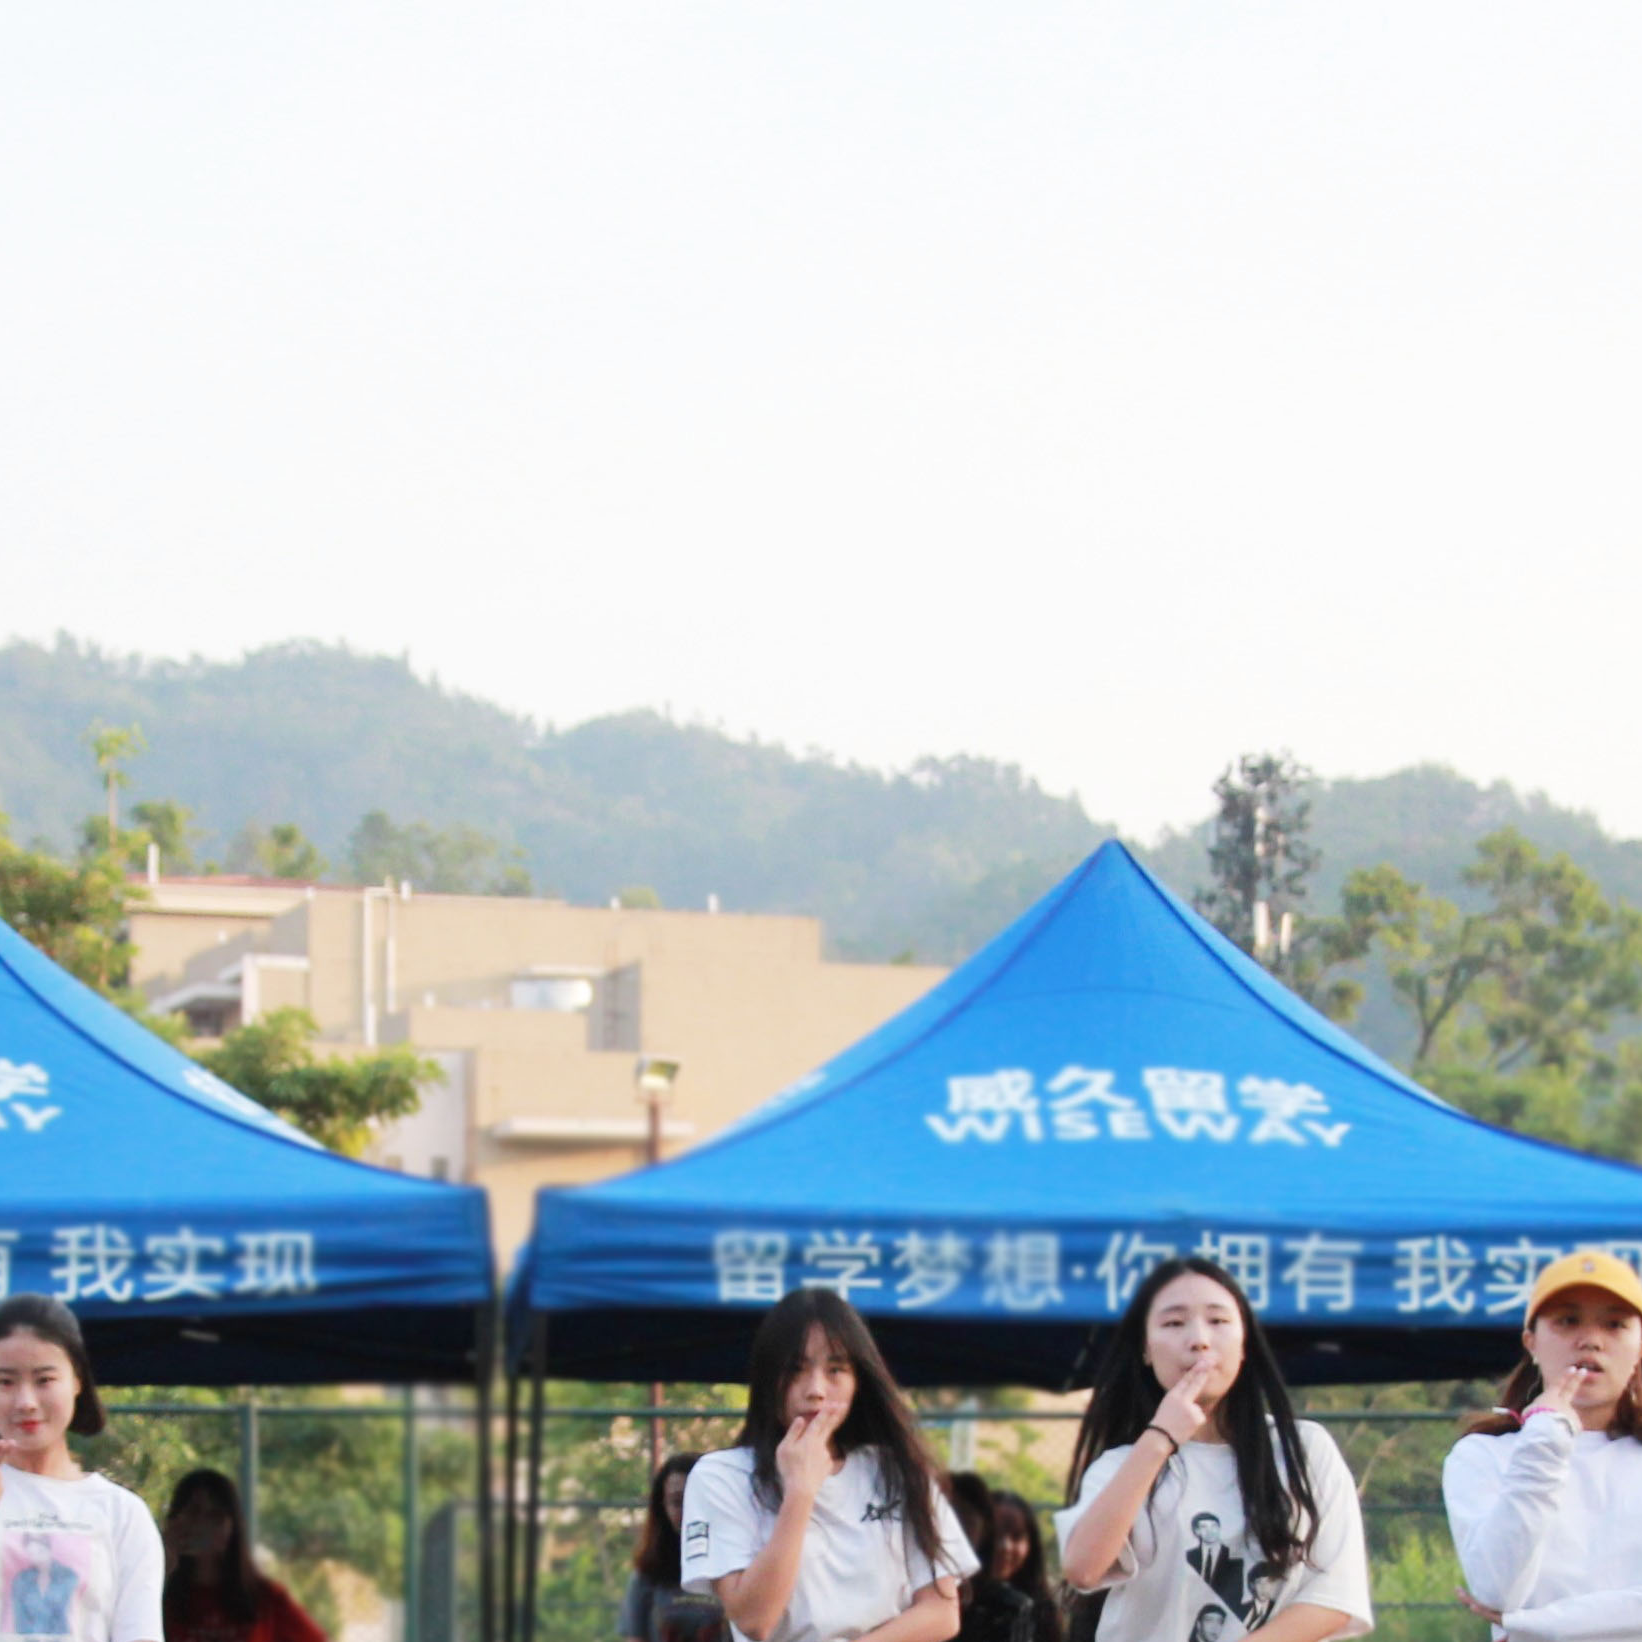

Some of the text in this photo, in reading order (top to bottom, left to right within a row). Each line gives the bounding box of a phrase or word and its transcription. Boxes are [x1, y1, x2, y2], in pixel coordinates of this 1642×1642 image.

[946, 1066, 1331, 1118] 威久留学
[925, 1110, 1352, 1147] WISEWAY
[50, 1222, 319, 1302] 我实现
